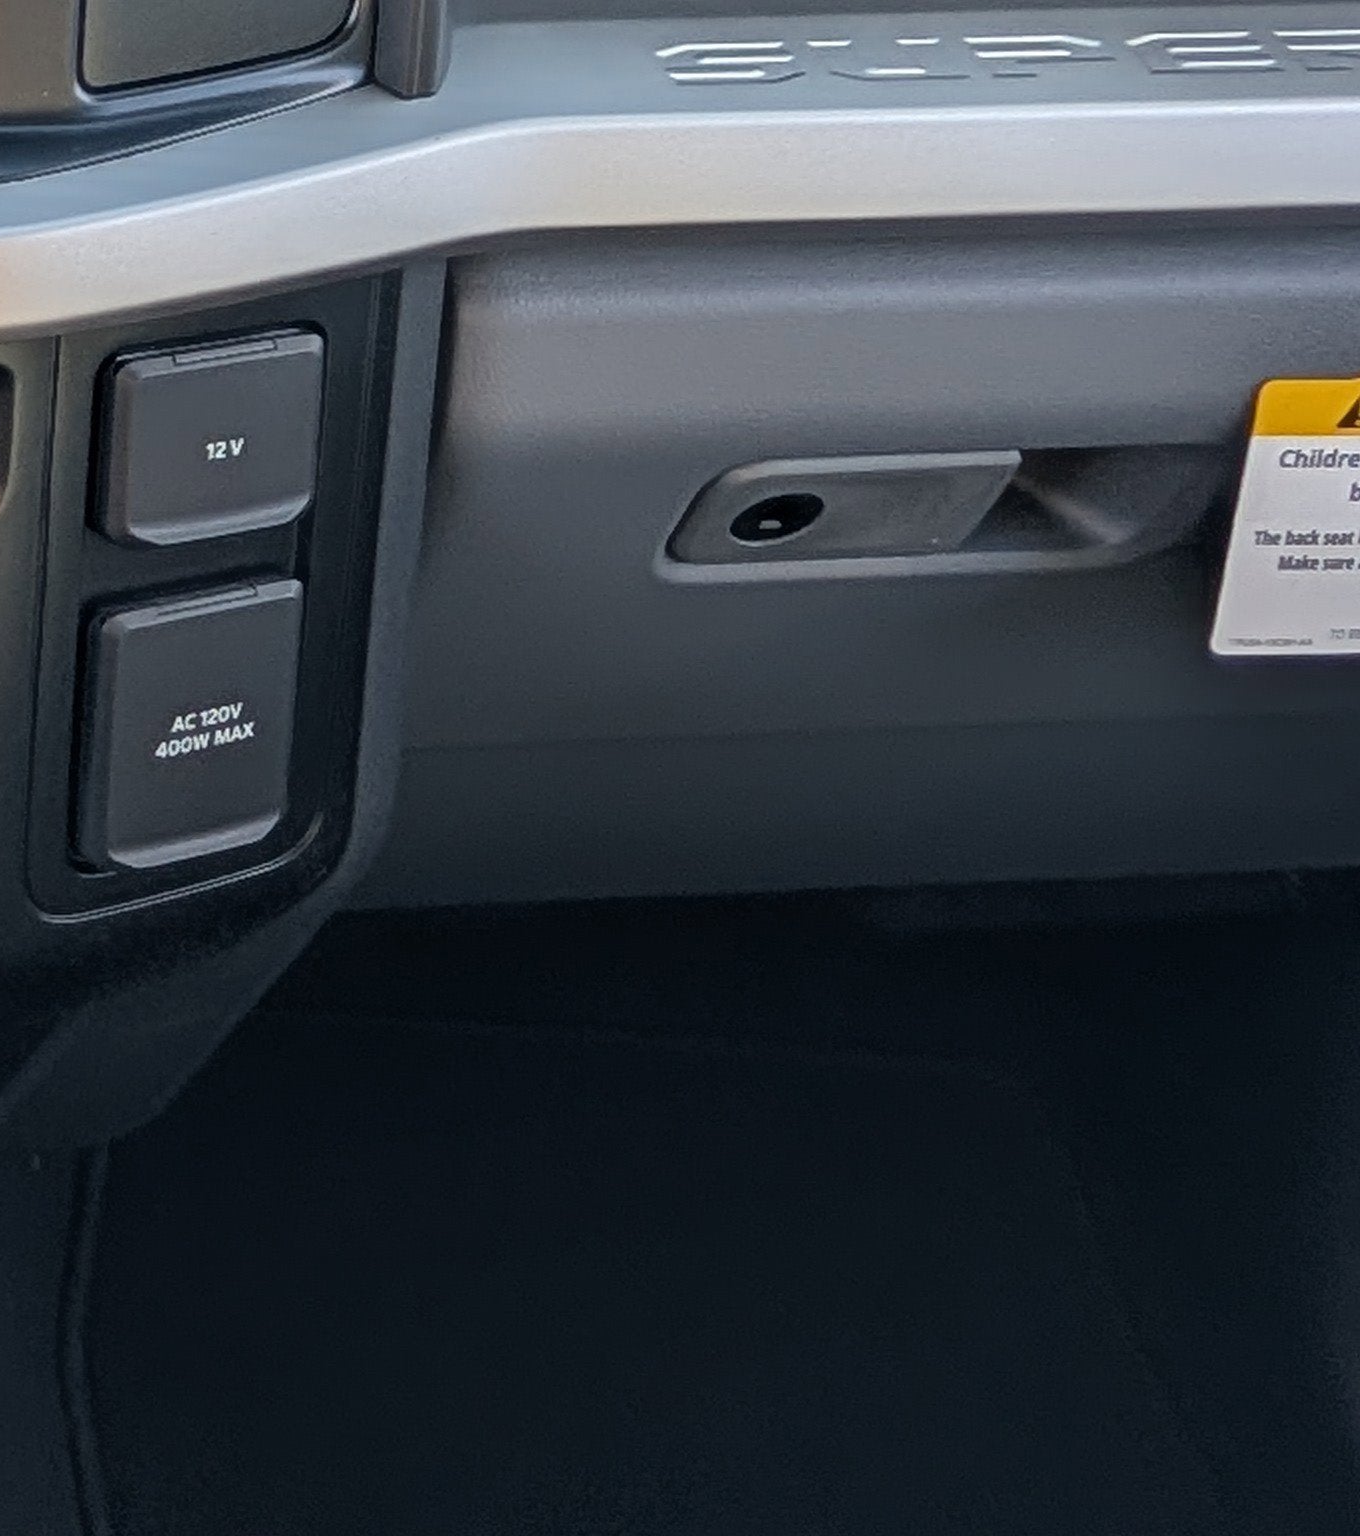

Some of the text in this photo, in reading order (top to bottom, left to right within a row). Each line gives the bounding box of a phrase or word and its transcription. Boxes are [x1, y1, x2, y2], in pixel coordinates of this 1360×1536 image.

[206, 437, 245, 460] 12 V
[1255, 530, 1282, 546] The
[1285, 530, 1320, 546] back
[1277, 555, 1319, 570] Make
[170, 701, 244, 733] AC 120V
[154, 719, 256, 758] 400W MAX
